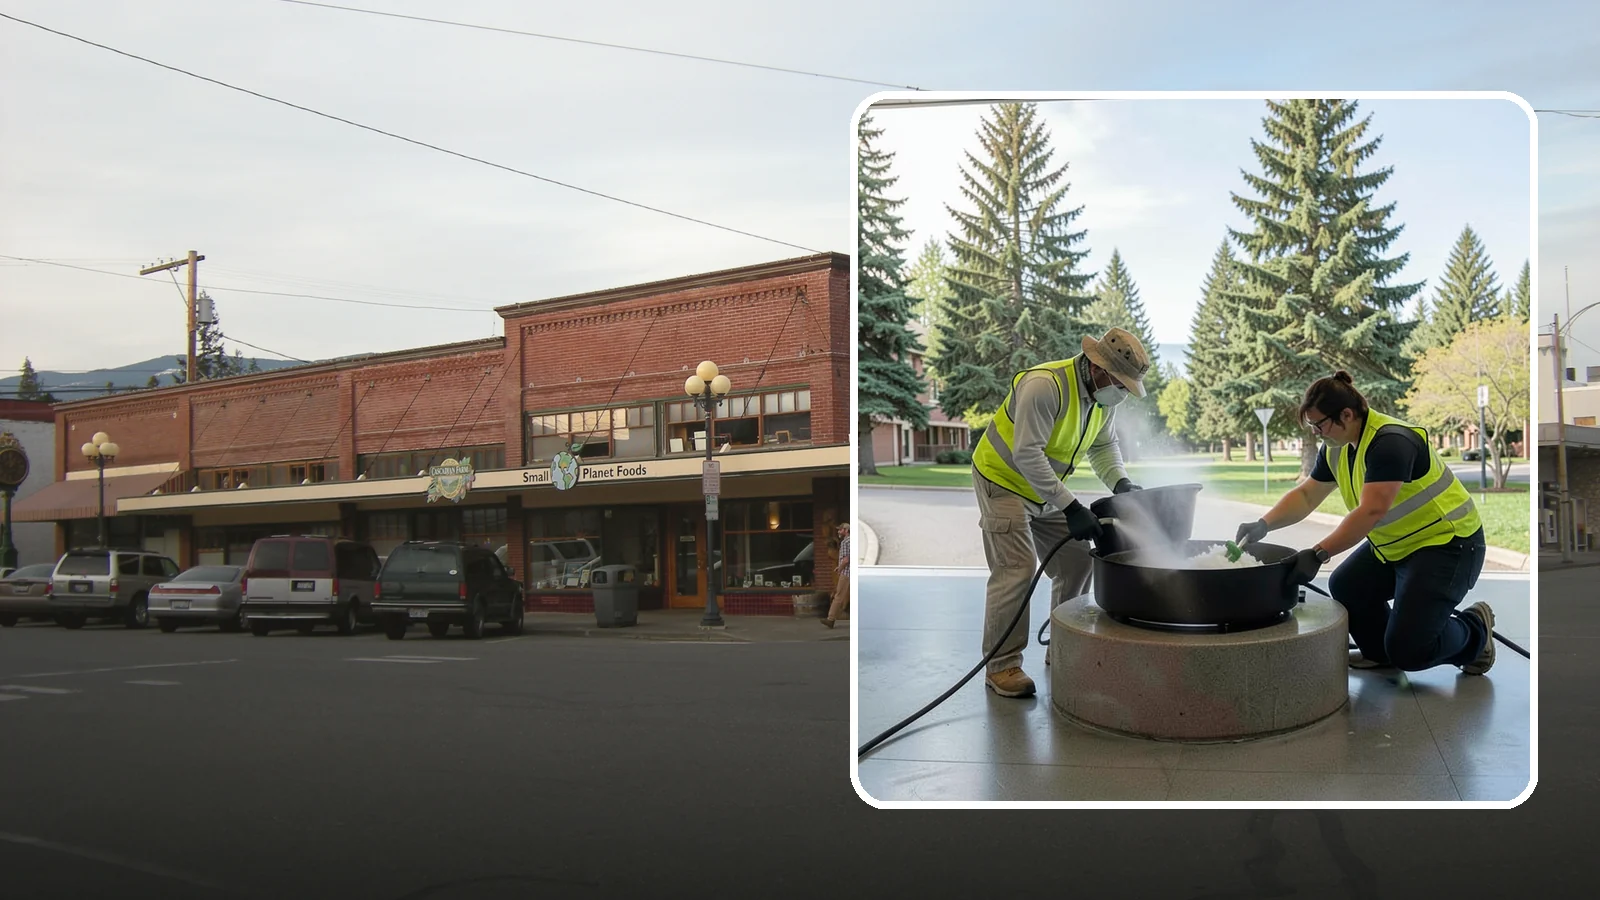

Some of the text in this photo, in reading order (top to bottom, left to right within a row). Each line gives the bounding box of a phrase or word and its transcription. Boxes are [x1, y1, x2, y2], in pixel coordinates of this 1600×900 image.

[523, 464, 647, 483] Small Planet Foods
